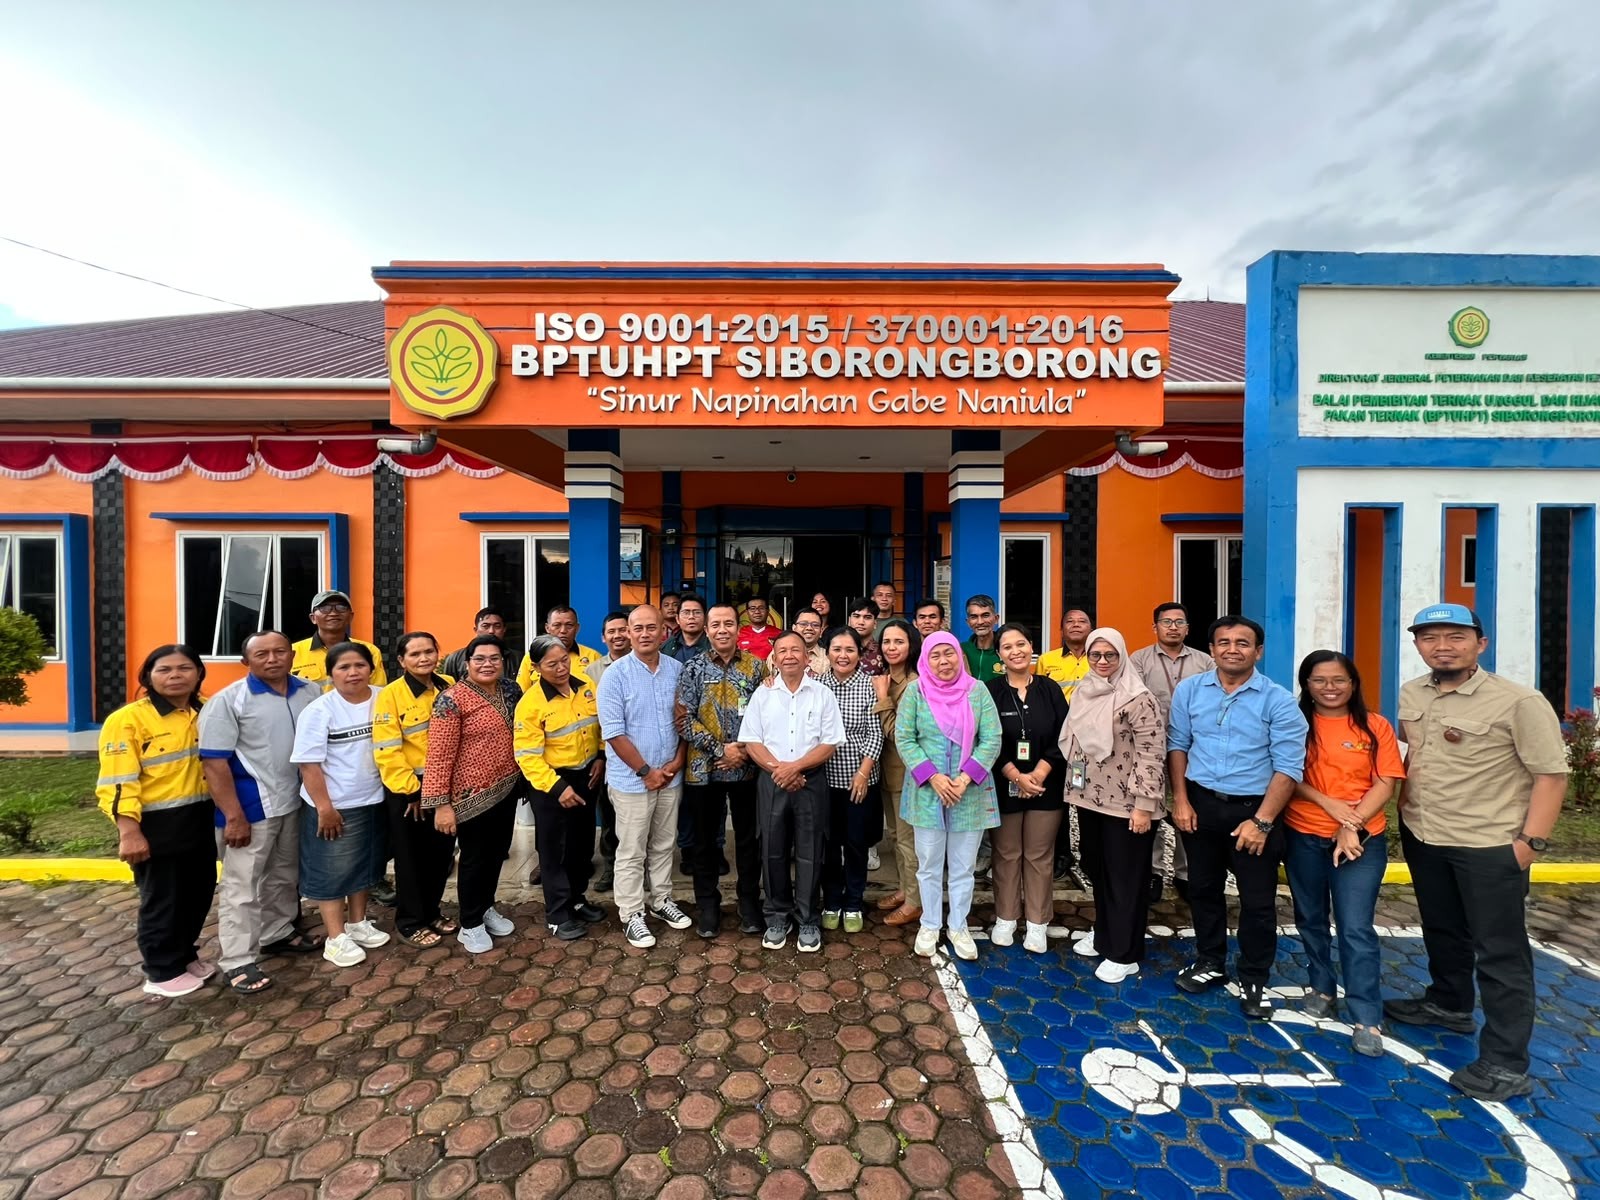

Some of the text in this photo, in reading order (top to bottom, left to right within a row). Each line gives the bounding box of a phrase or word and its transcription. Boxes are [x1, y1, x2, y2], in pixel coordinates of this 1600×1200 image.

[534, 312, 1125, 345] ISO 9001:2015 / 370001:2016
[510, 344, 1163, 380] BPTUHPT SIBORONGBORONG
[1381, 373, 1434, 384] JENDERAL
[587, 385, 1087, 419] "Sinur Napinahan Gabe Naniula"
[1312, 393, 1351, 407] BALAI
[1352, 393, 1428, 407] PEMBIBITAN
[1430, 393, 1482, 407] TERNAK
[1484, 393, 1539, 408] UNGGUL
[1540, 393, 1568, 407] DAN
[1323, 409, 1367, 423] PAKAN
[1368, 409, 1421, 423] TERNAK
[1422, 409, 1490, 425] (BPTUHPT)
